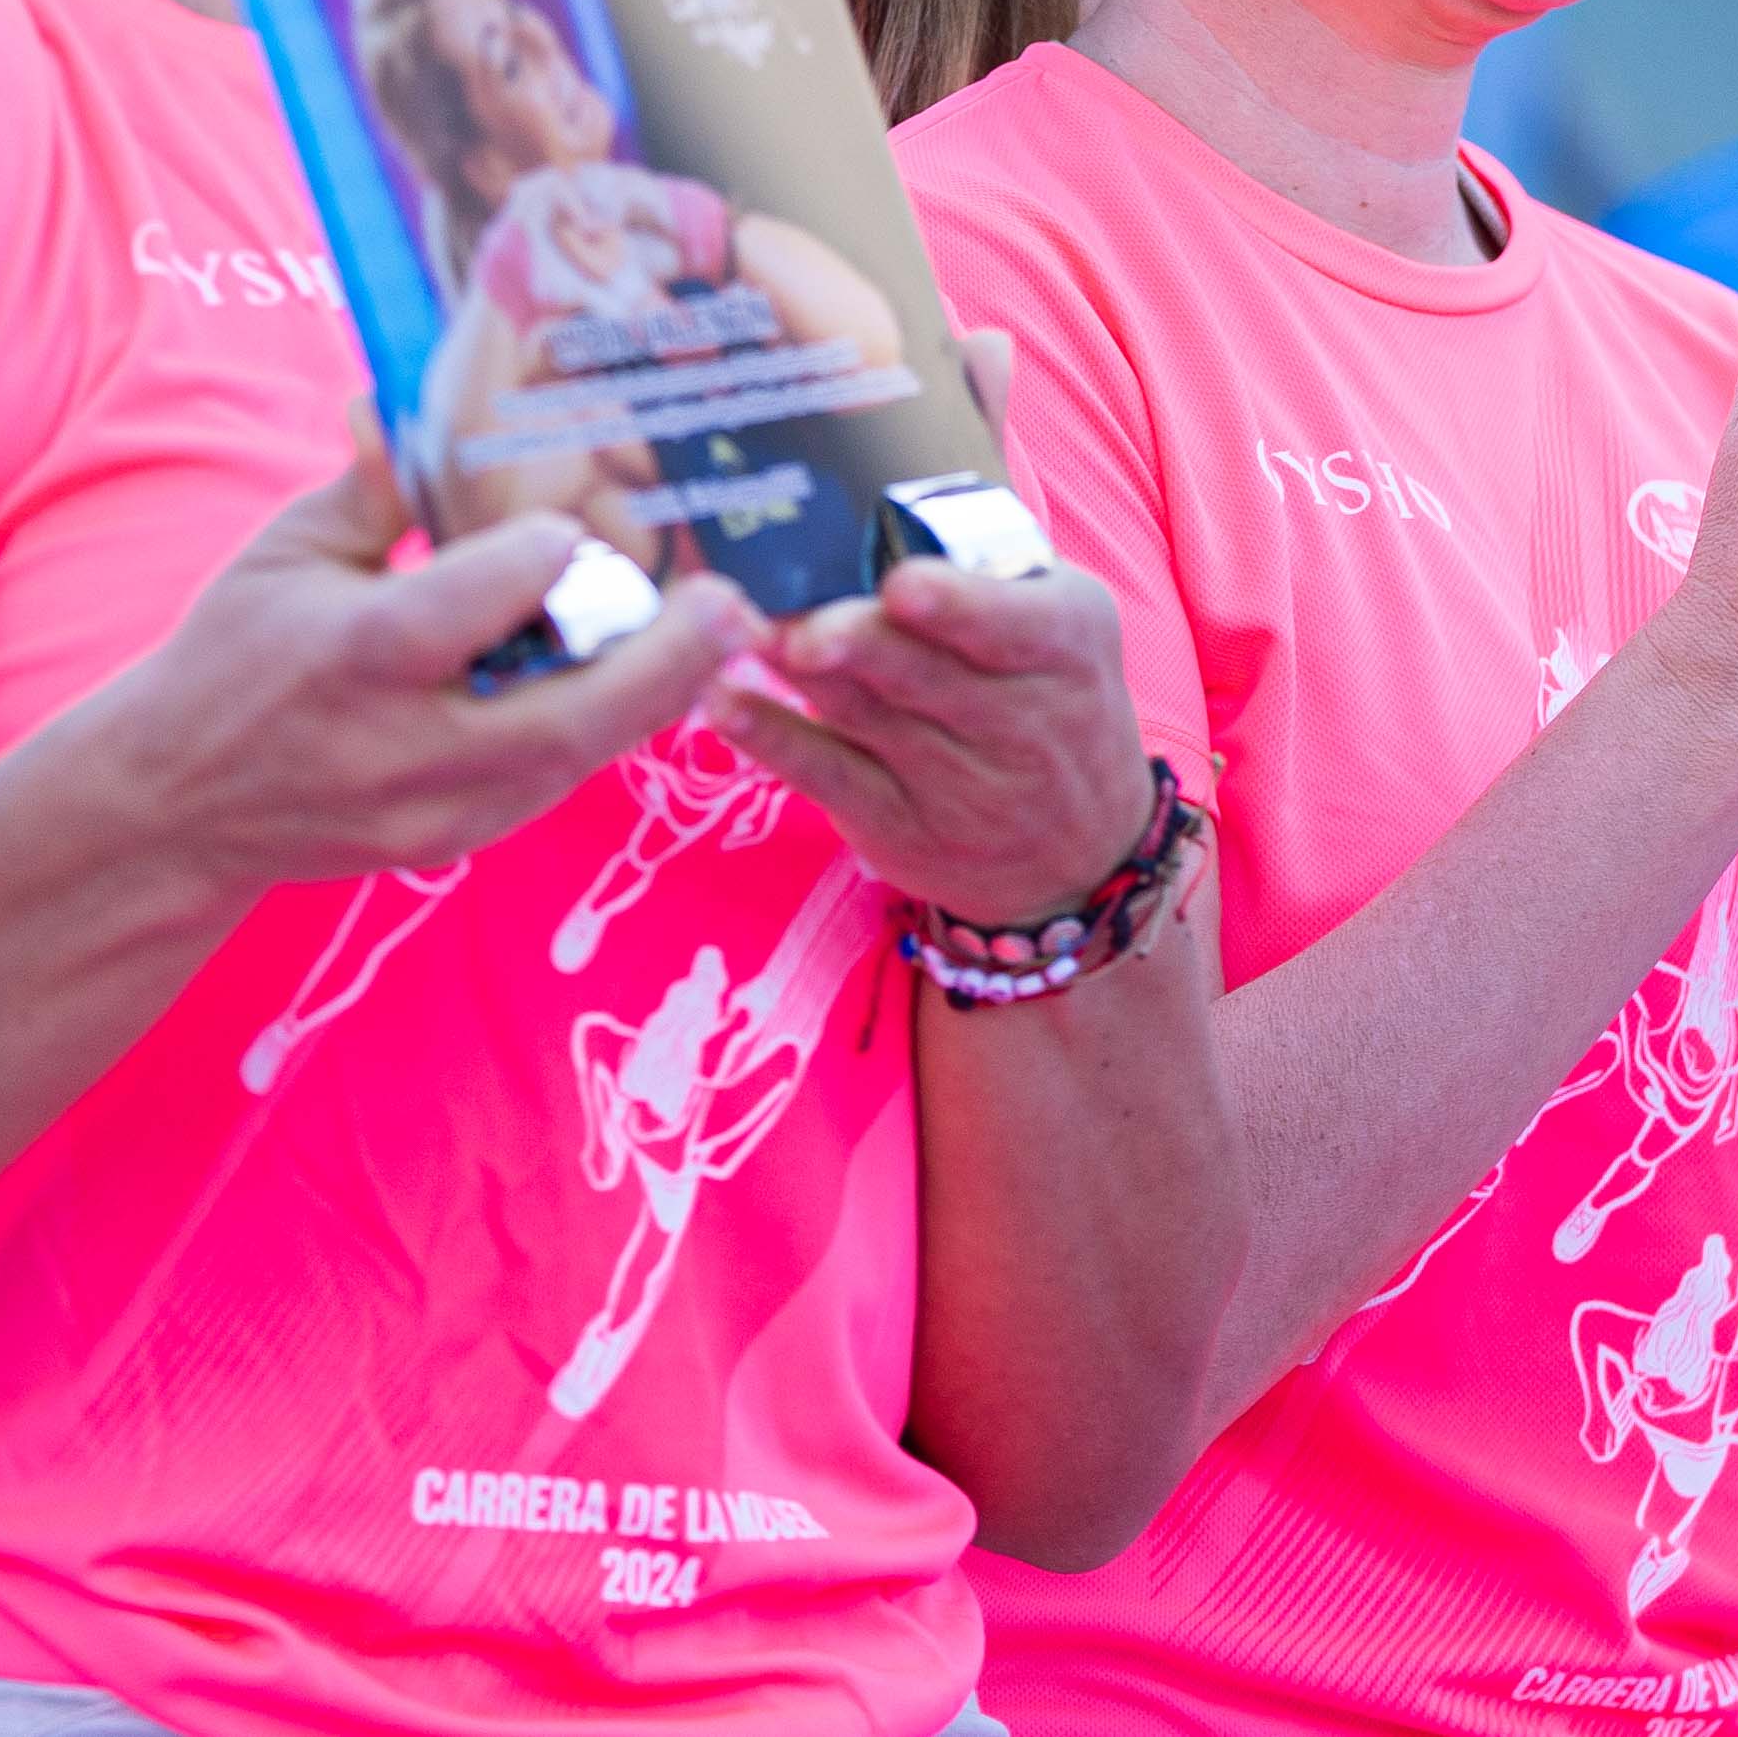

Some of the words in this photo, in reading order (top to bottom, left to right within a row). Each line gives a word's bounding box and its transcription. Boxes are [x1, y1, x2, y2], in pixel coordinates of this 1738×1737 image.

[412, 1468, 608, 1534] CARRERA
[617, 1483, 678, 1541] DE
[685, 1487, 729, 1543] LA
[600, 1547, 702, 1607] 2024
[1513, 1666, 1674, 1713] CARRERA
[1674, 1663, 1713, 1713] DE
